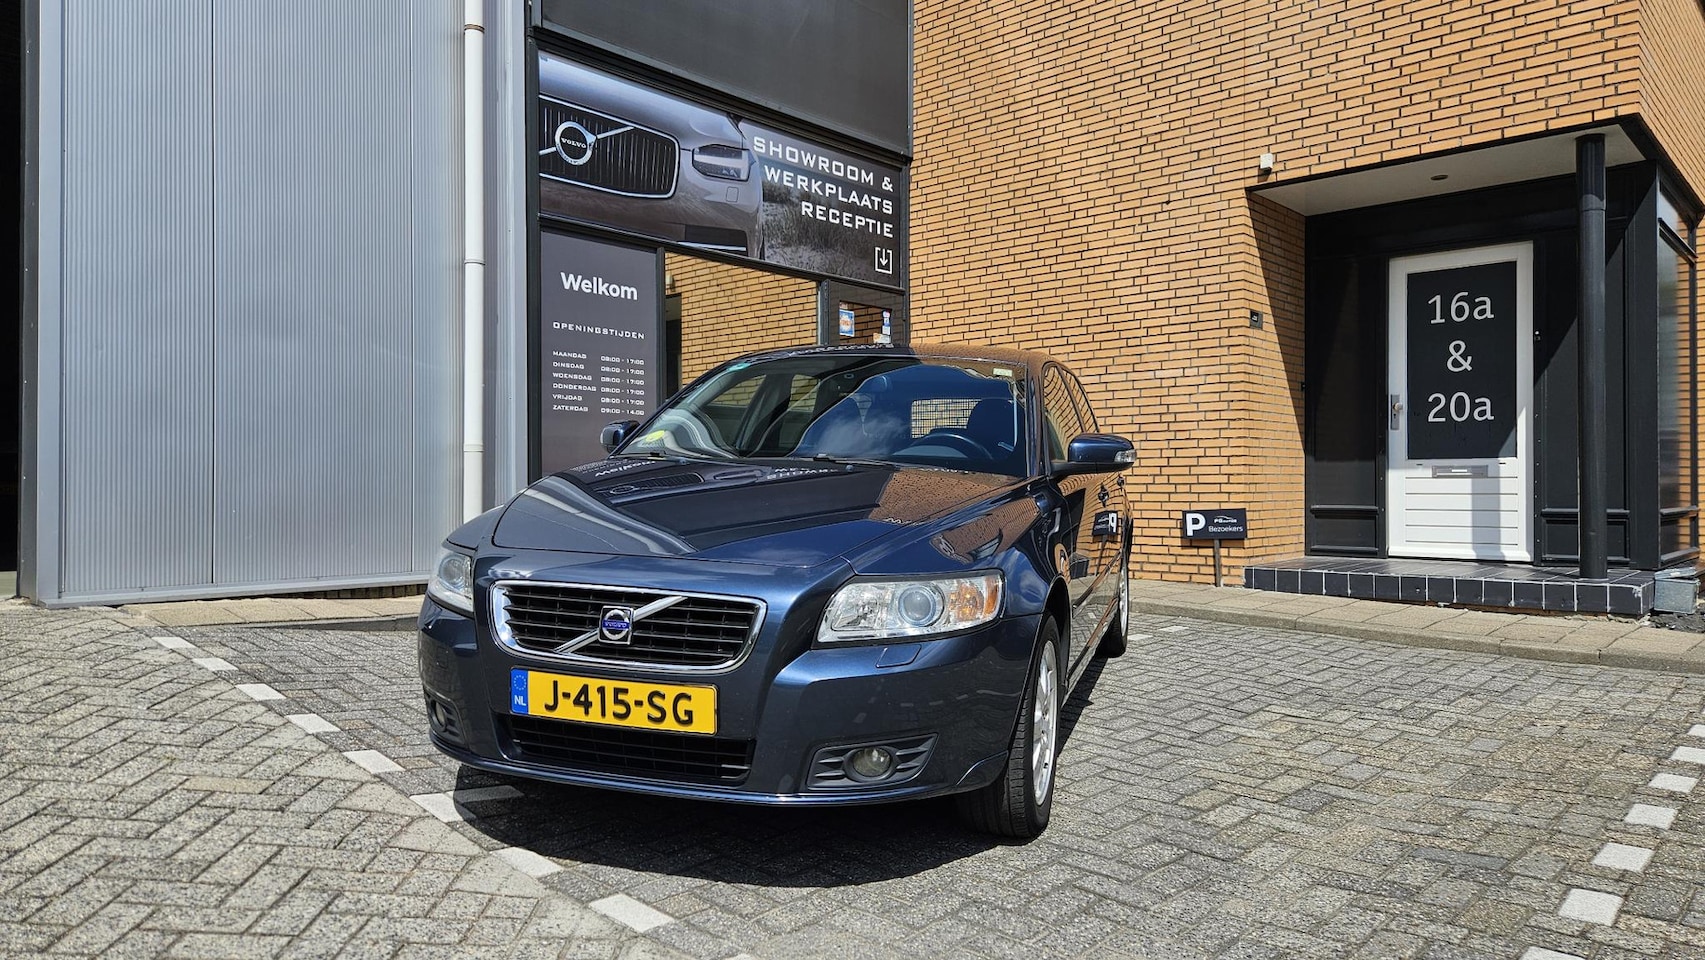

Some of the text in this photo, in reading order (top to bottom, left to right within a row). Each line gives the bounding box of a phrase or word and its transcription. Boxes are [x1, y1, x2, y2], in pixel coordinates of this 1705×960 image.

[560, 137, 587, 149] VOLVO
[753, 136, 894, 193] SHOWROOM &
[764, 165, 893, 215] WERKPLAATS
[801, 201, 894, 239] RECEPTIE
[560, 271, 638, 301] Welkom
[1427, 291, 1495, 325] 16a
[552, 321, 645, 340] OPENINGSTIJDEN
[552, 350, 587, 359] MAANDAG
[1446, 339, 1473, 373] &
[552, 361, 585, 370] DINSDAG
[552, 372, 593, 381] WOENSDAG
[552, 383, 597, 392] DONDERDAG
[552, 393, 583, 401] VRIJDAG
[552, 404, 589, 412] ZATERDAG
[1427, 391, 1495, 424] 20a
[1185, 512, 1206, 537] P
[1208, 525, 1244, 533] Bezoekers
[514, 694, 527, 707] NL
[544, 679, 694, 726] J-415-SG
